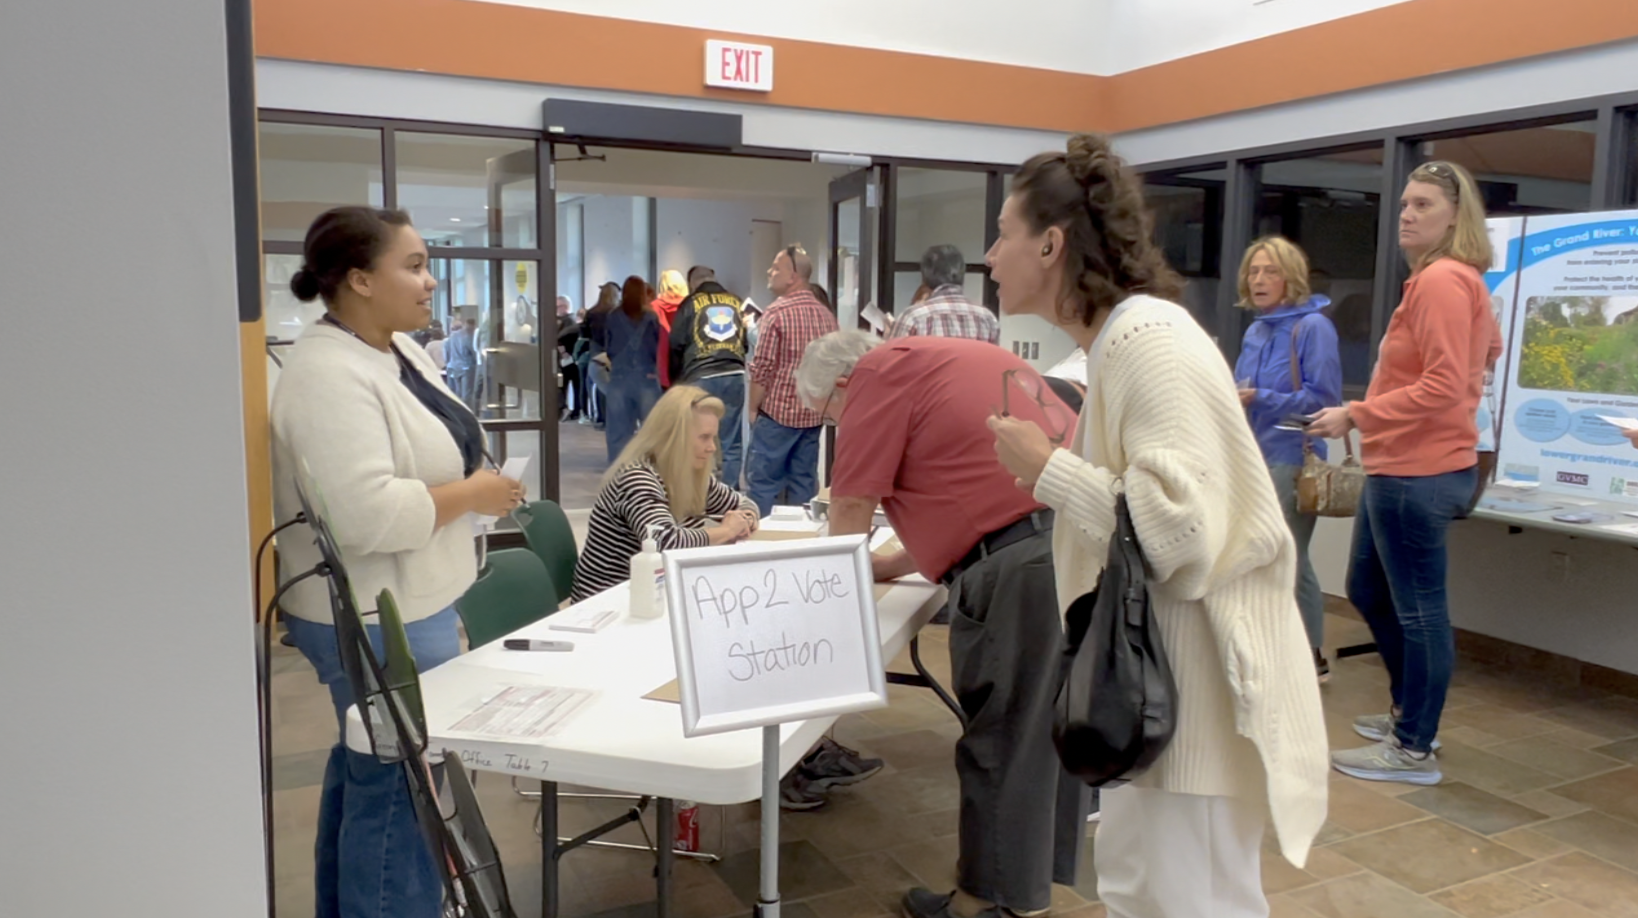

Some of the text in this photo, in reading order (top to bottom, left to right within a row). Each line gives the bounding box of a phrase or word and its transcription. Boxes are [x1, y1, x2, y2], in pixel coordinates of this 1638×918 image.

[721, 47, 763, 84] EXIT
[1531, 244, 1551, 255] The
[1554, 232, 1589, 247] Grand
[1593, 228, 1624, 238] River:
[694, 294, 711, 313] AIR
[1558, 473, 1588, 484] GVMC
[791, 569, 850, 605] Vote
[728, 631, 834, 682] Station
[460, 748, 493, 767] Office
[504, 753, 532, 771] Table
